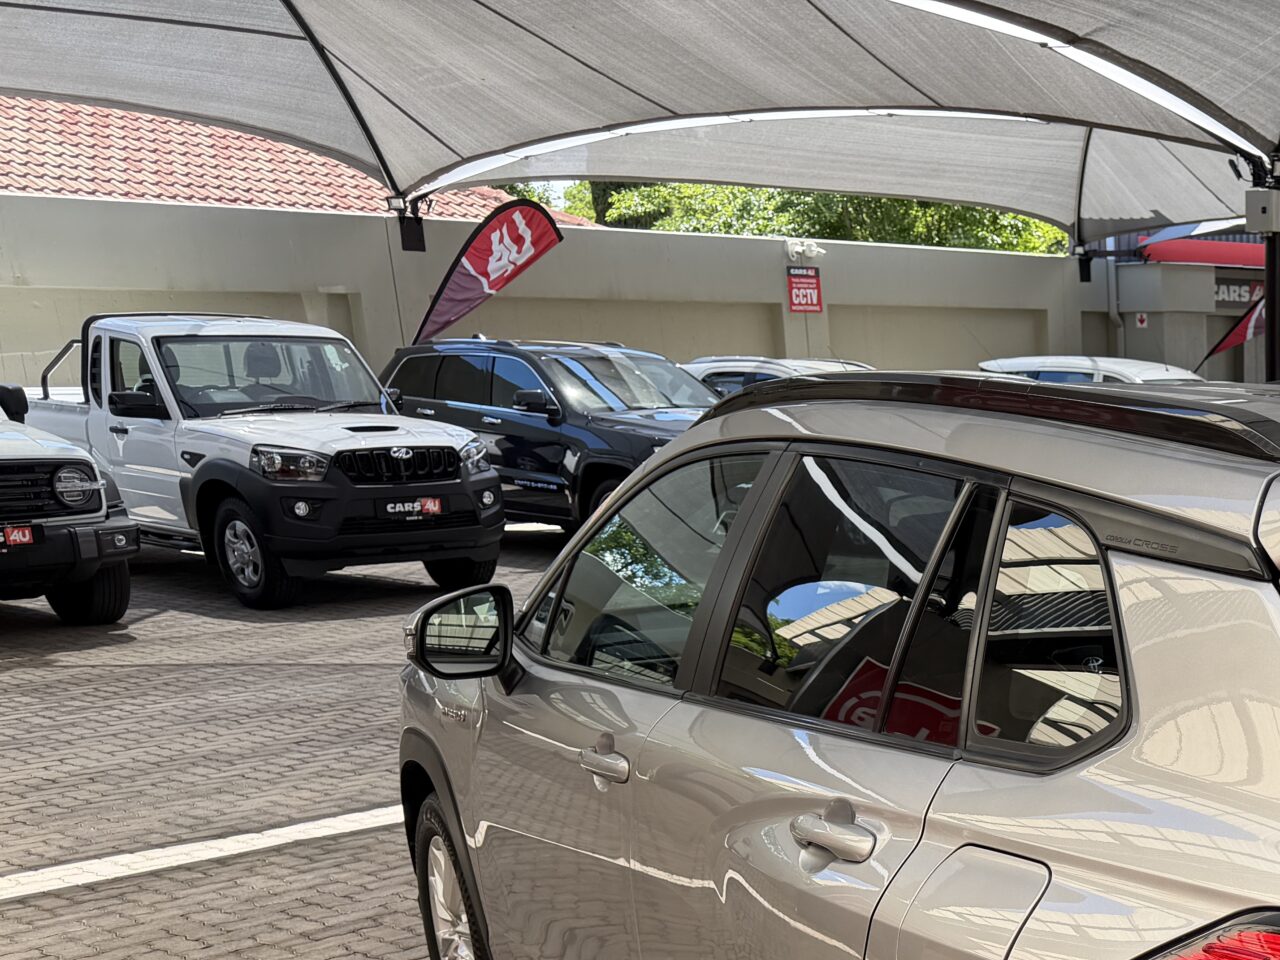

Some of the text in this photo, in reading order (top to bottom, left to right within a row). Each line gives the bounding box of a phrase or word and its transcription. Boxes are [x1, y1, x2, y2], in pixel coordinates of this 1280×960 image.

[486, 209, 535, 281] 4U
[792, 288, 818, 305] CCTV
[386, 499, 439, 513] CARS 4U
[9, 529, 30, 542] 4U
[1132, 538, 1179, 554] CROSS
